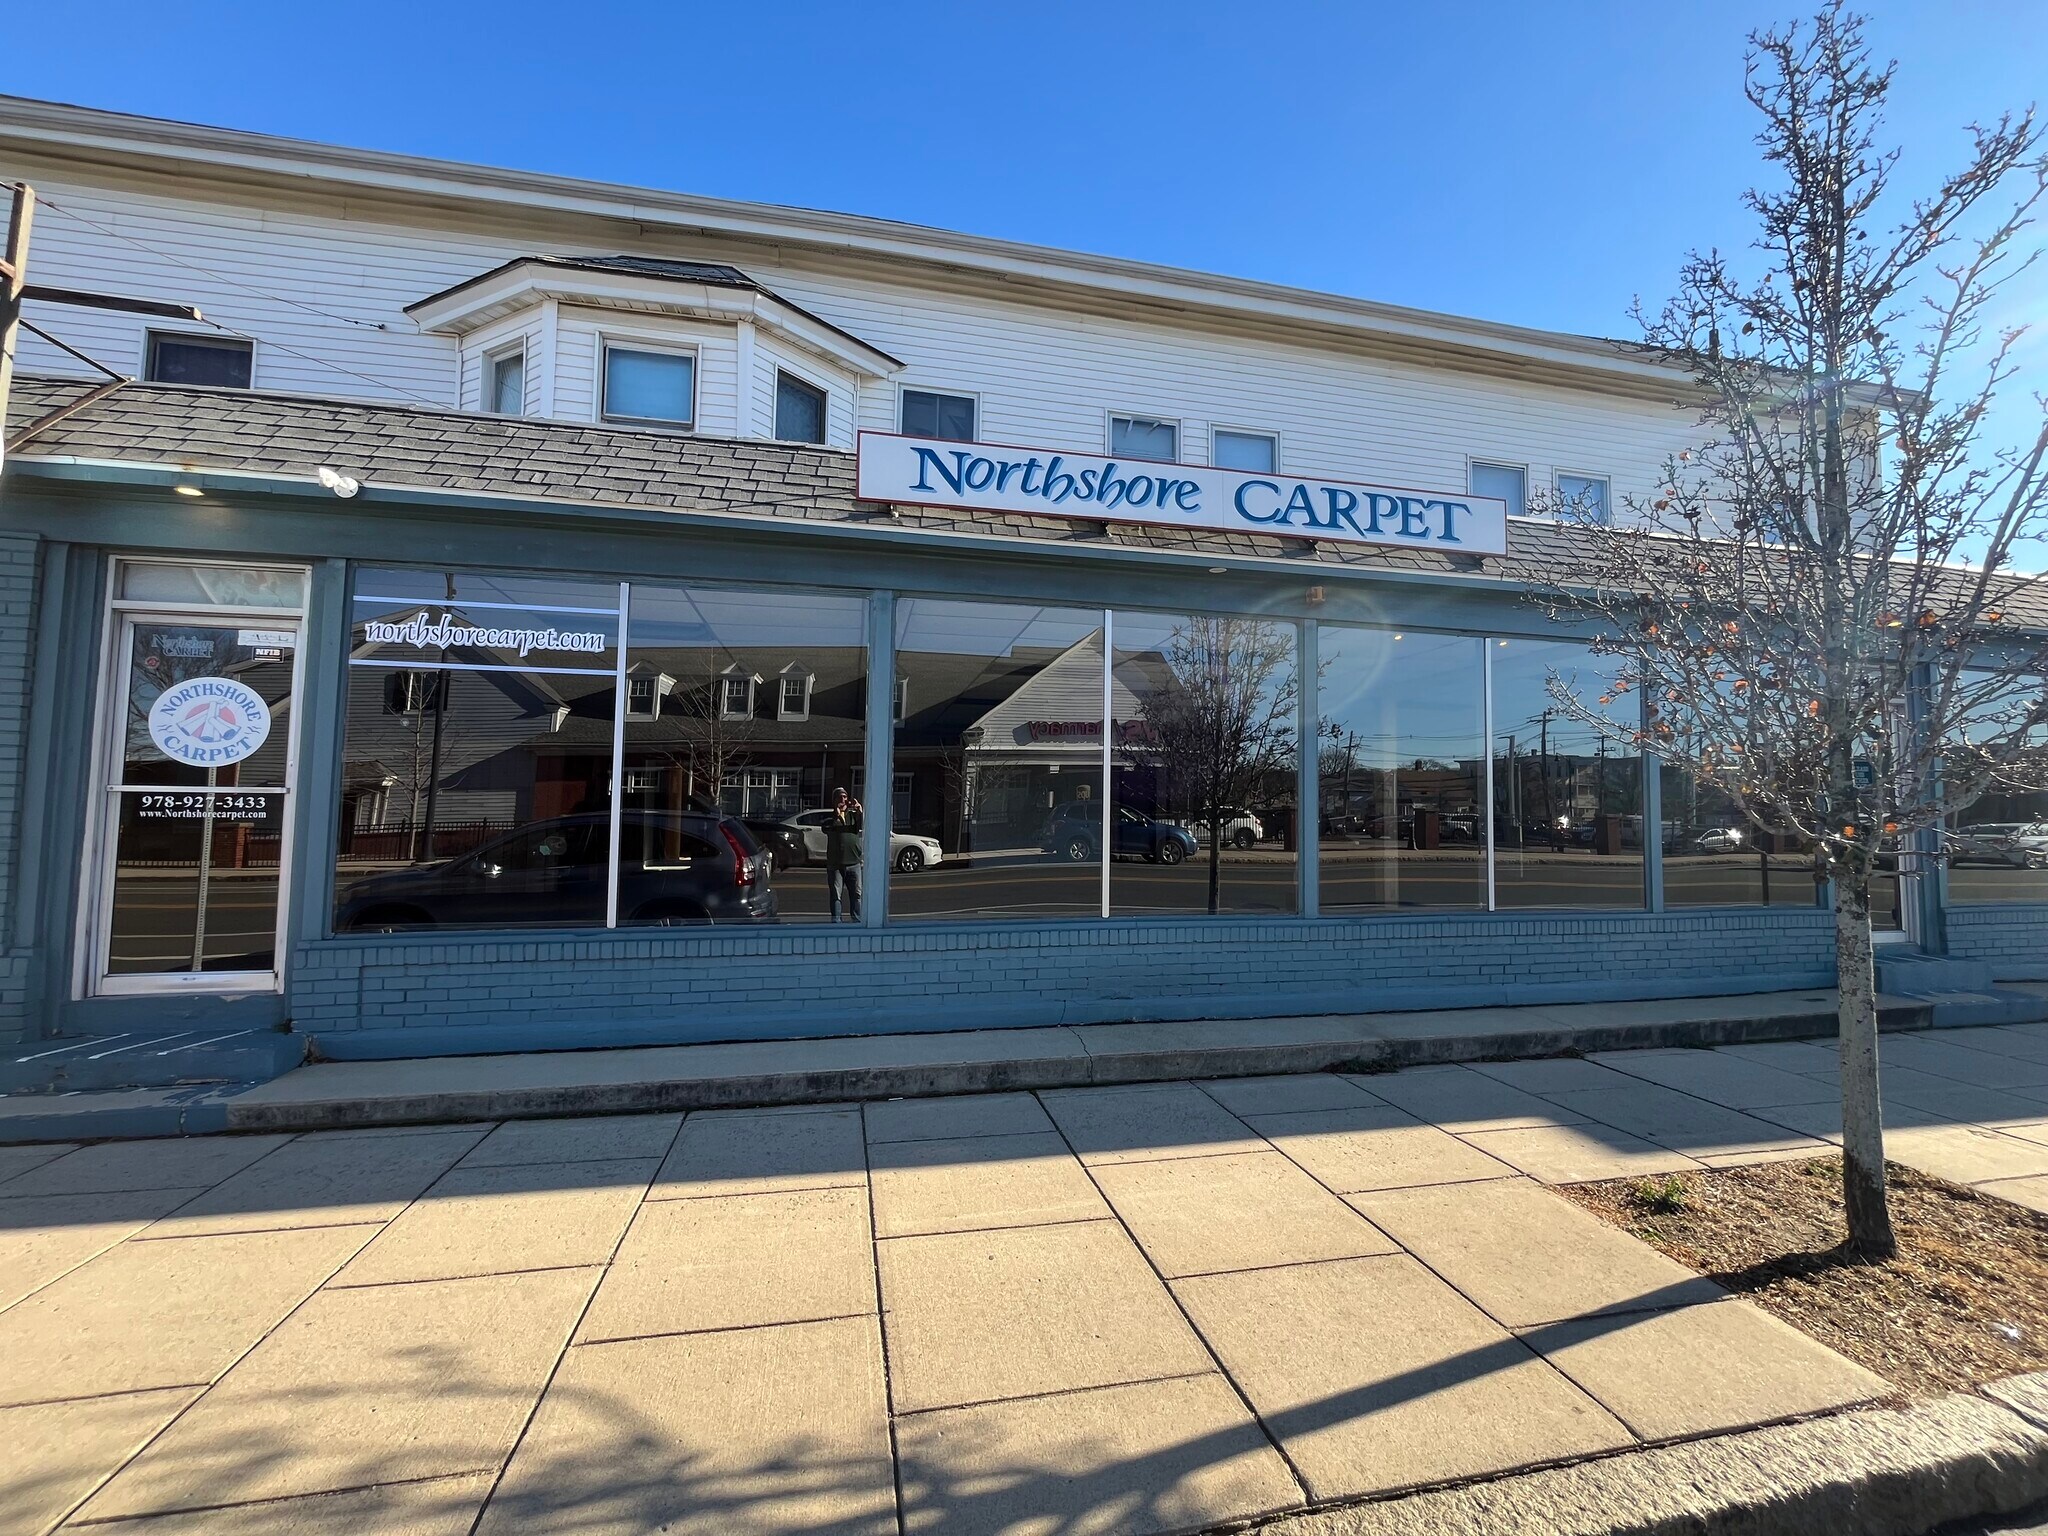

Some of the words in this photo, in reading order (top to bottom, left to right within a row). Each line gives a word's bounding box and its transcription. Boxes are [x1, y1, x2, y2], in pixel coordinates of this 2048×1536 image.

[909, 447, 1201, 511] Northshore
[1233, 480, 1472, 543] CARPET
[365, 612, 606, 657] northshorecarpet.com
[255, 648, 281, 656] NFIB
[160, 683, 262, 722] NORTHSHORE
[164, 735, 252, 762] CARPET
[139, 809, 267, 820] www.Northshorecarpet.com
[141, 795, 267, 809] 978-927-3433
